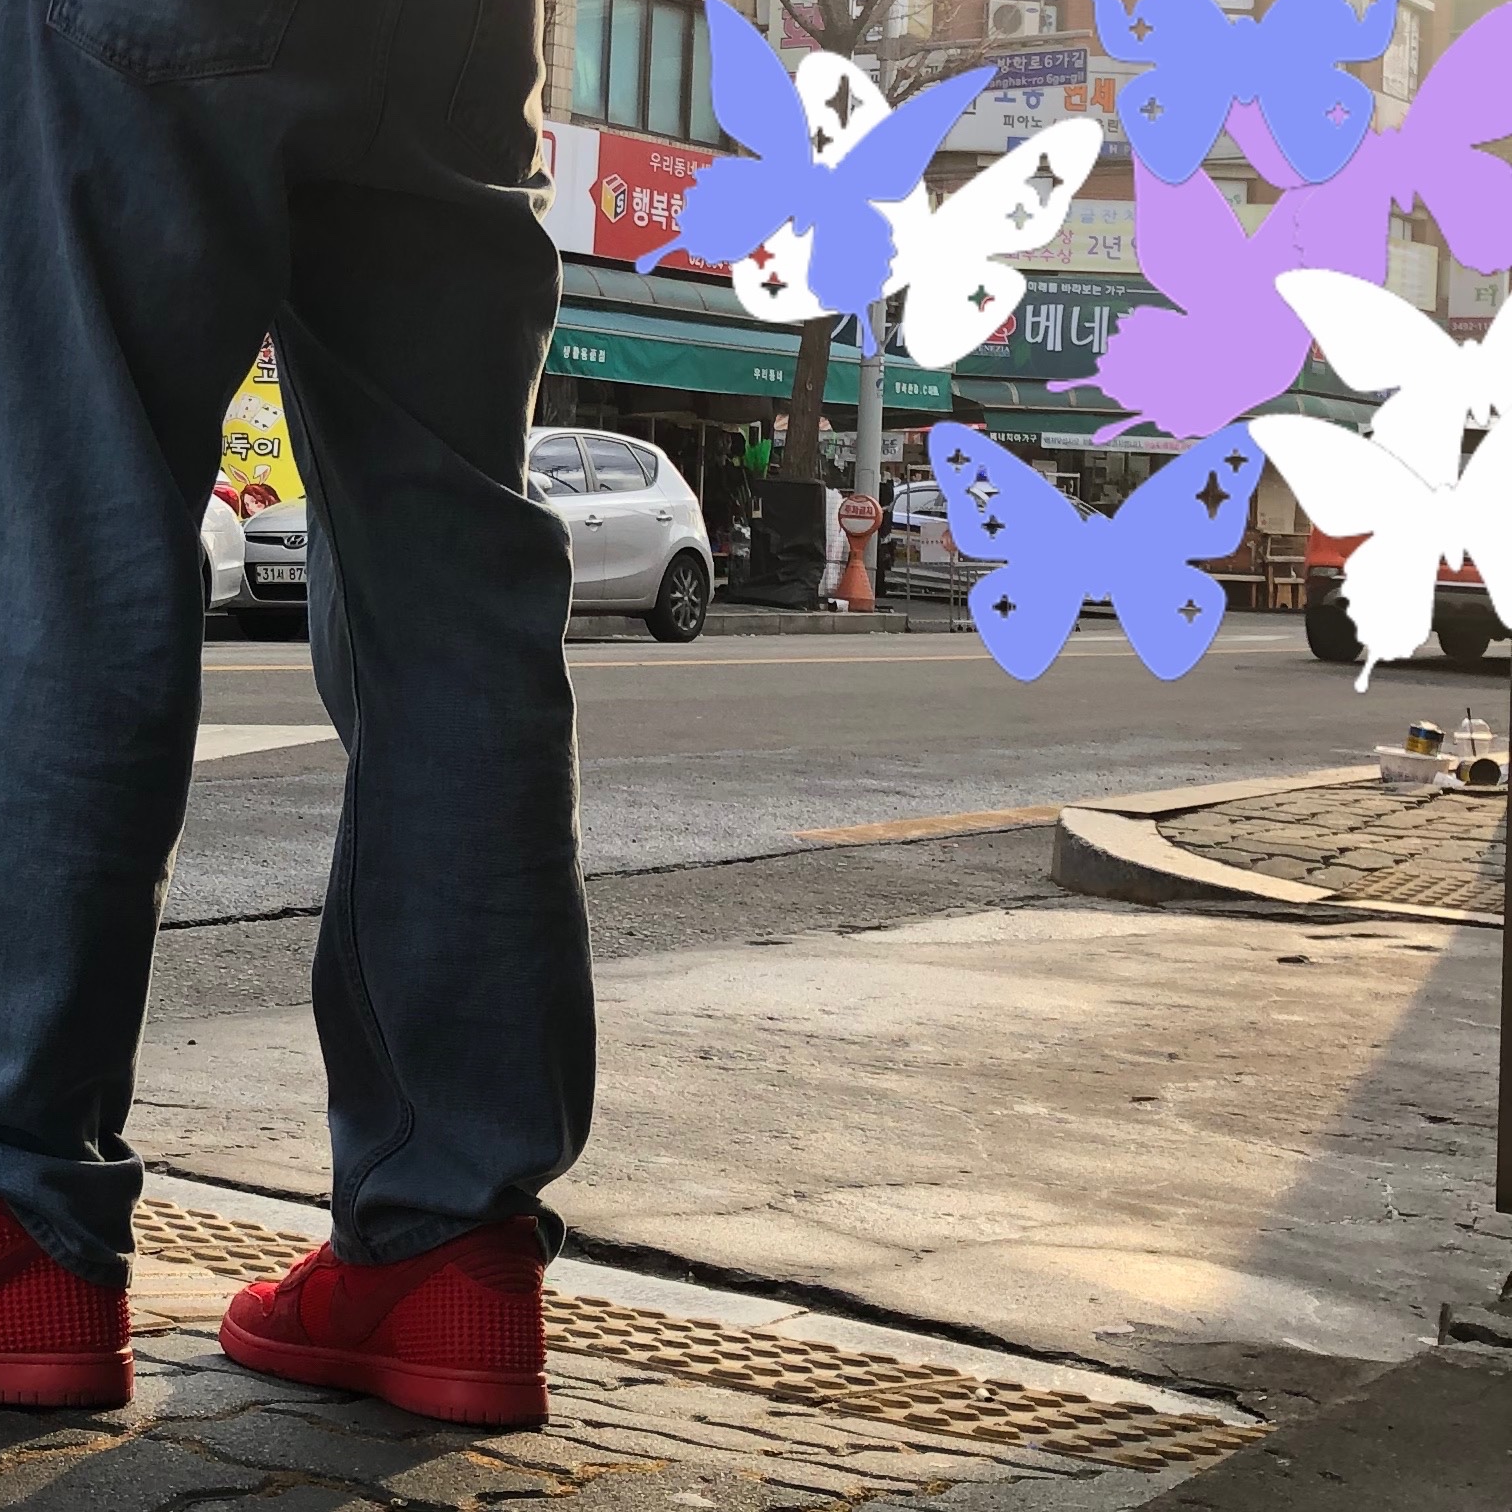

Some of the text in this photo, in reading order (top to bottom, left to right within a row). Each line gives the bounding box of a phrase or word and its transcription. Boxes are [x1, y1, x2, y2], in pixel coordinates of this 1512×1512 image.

[996, 51, 1085, 74] 방학로6가길
[989, 76, 1043, 88] anghak-ro
[1003, 114, 1043, 128] 피아노
[649, 152, 699, 179] 우리동네
[1088, 235, 1122, 261] 2년
[1061, 282, 1102, 296] 바라보는
[1105, 285, 1127, 296] 가구
[1024, 303, 1135, 353] 베네
[977, 344, 1010, 353] ENEZIA
